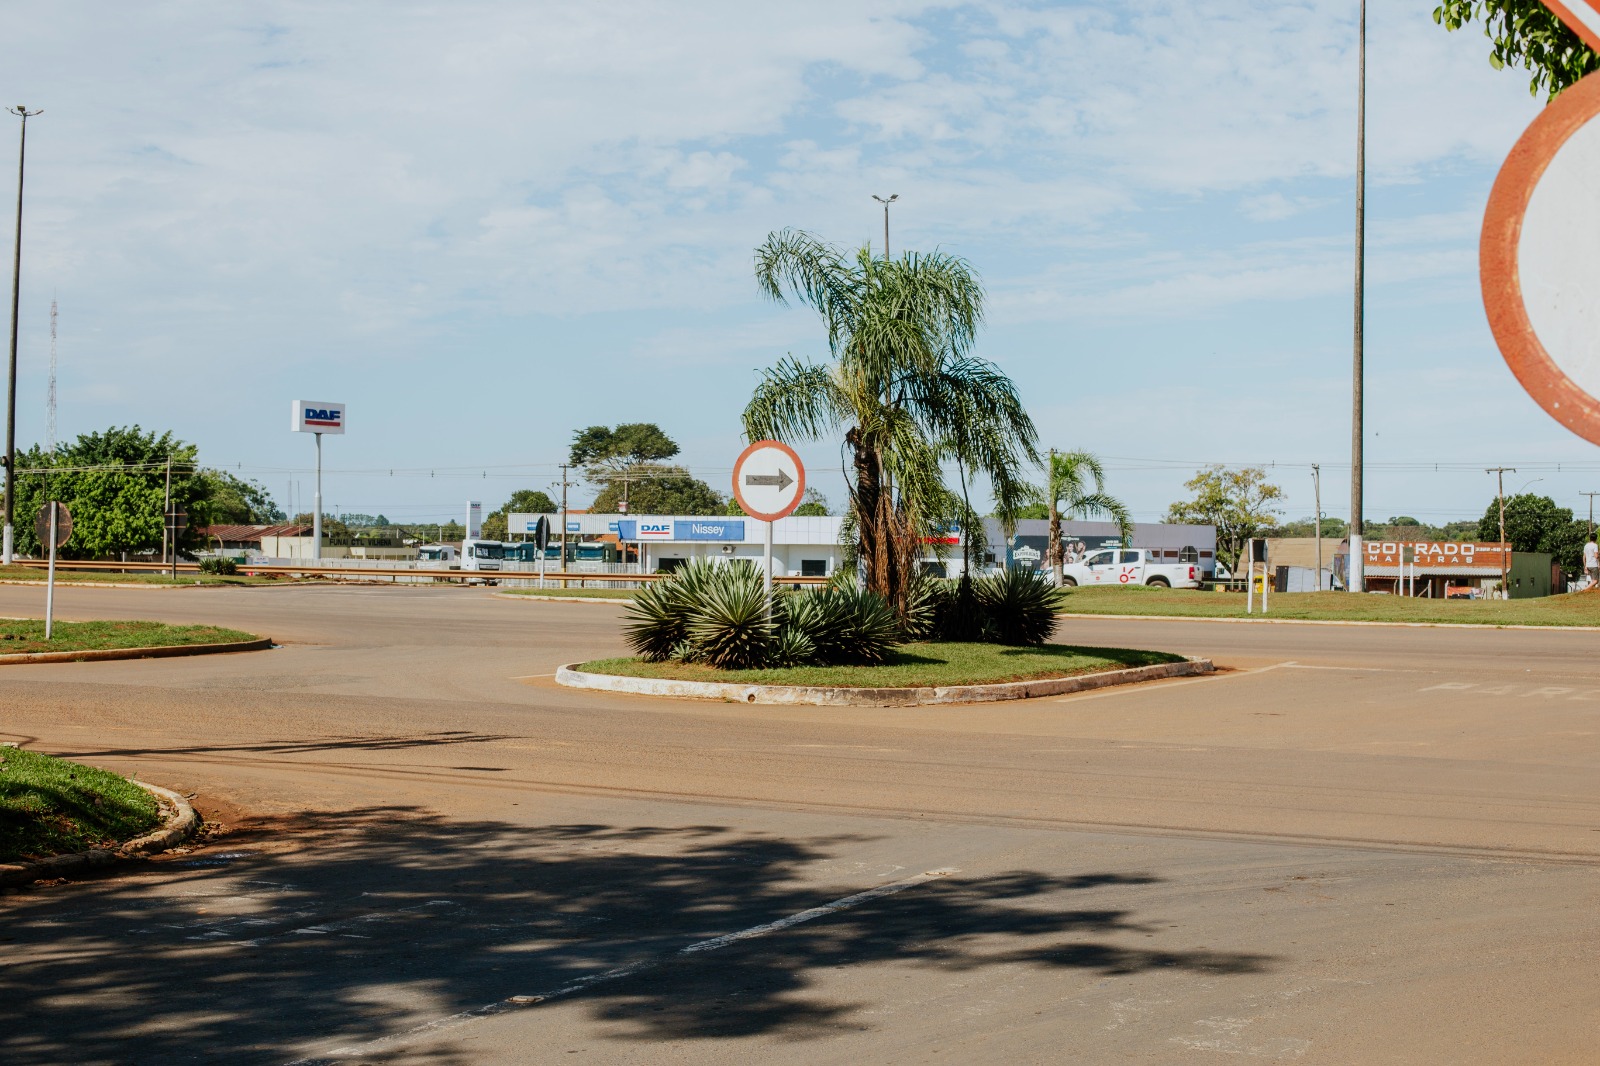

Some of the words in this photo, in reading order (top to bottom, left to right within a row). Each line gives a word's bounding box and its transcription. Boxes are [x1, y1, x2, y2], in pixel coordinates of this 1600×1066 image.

[305, 408, 341, 420] DAF
[692, 523, 725, 536] Nissey
[329, 538, 349, 546] FUNAI
[1369, 555, 1473, 564] MAEIRAS
